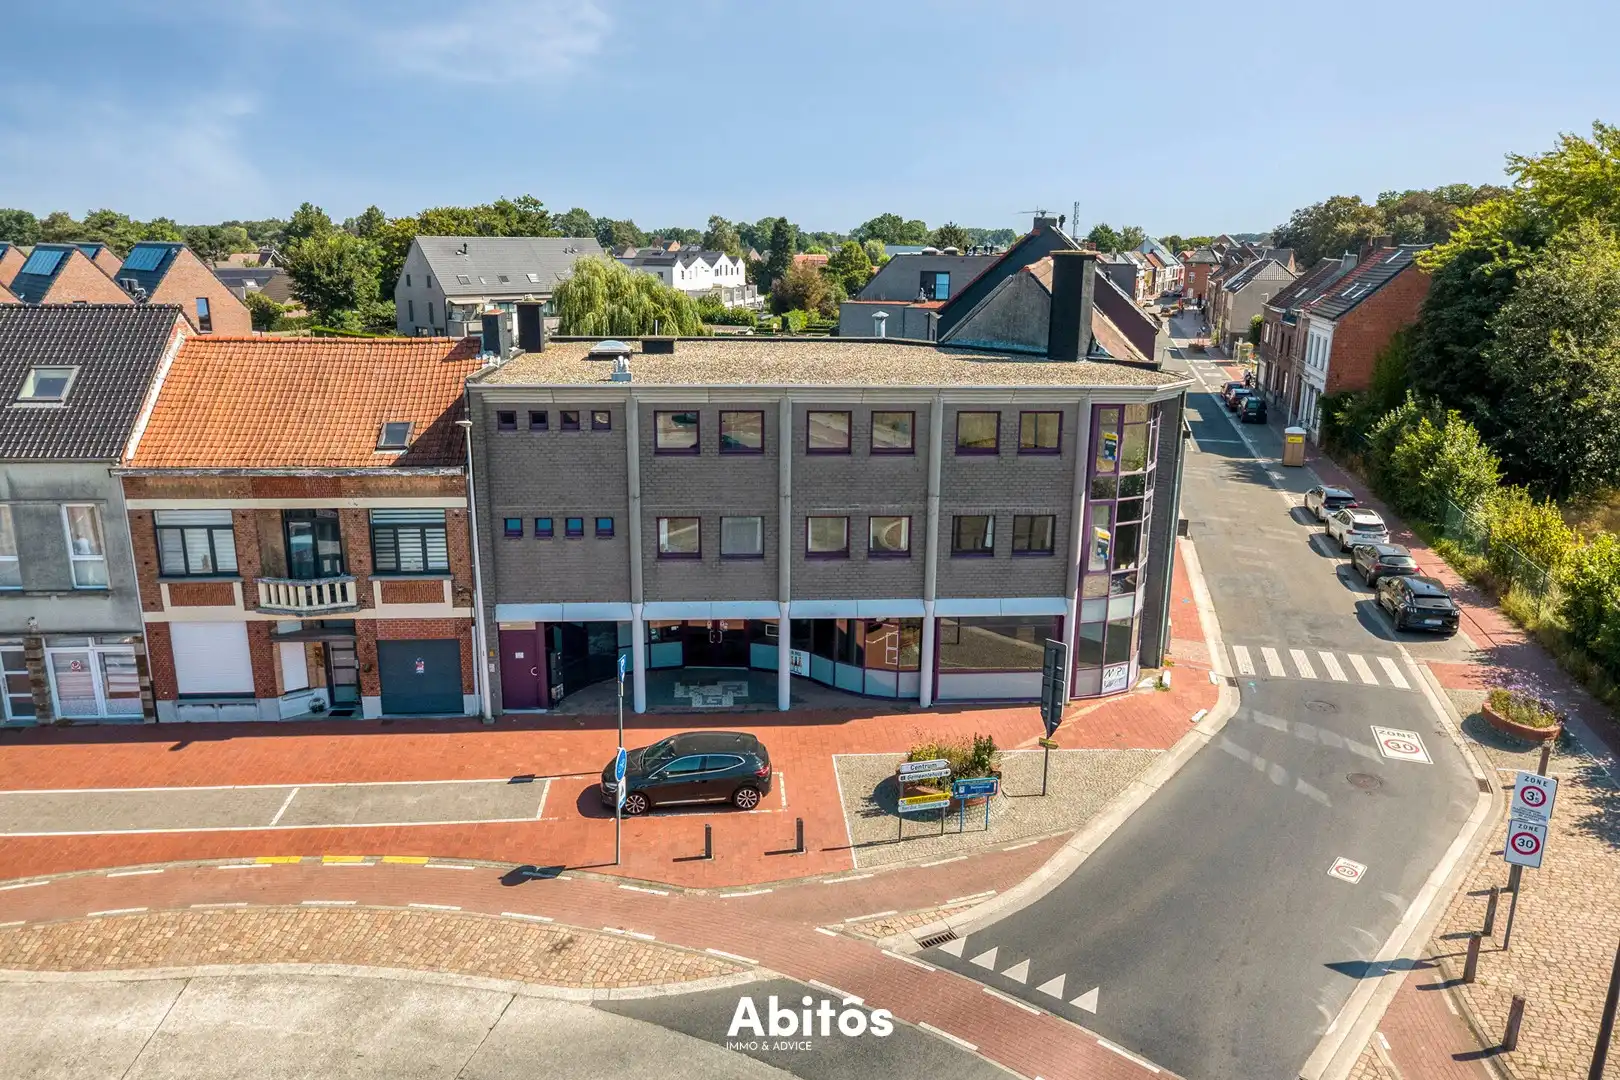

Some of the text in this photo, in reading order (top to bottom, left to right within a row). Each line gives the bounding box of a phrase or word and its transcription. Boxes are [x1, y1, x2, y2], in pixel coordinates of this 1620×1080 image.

[1378, 729, 1415, 739] ZONE
[1390, 741, 1414, 751] 30
[910, 763, 937, 771] Centrum
[1524, 775, 1549, 788] ZONE
[1518, 823, 1539, 833] ZONE
[1517, 838, 1534, 849] 30
[1340, 867, 1354, 876] 30
